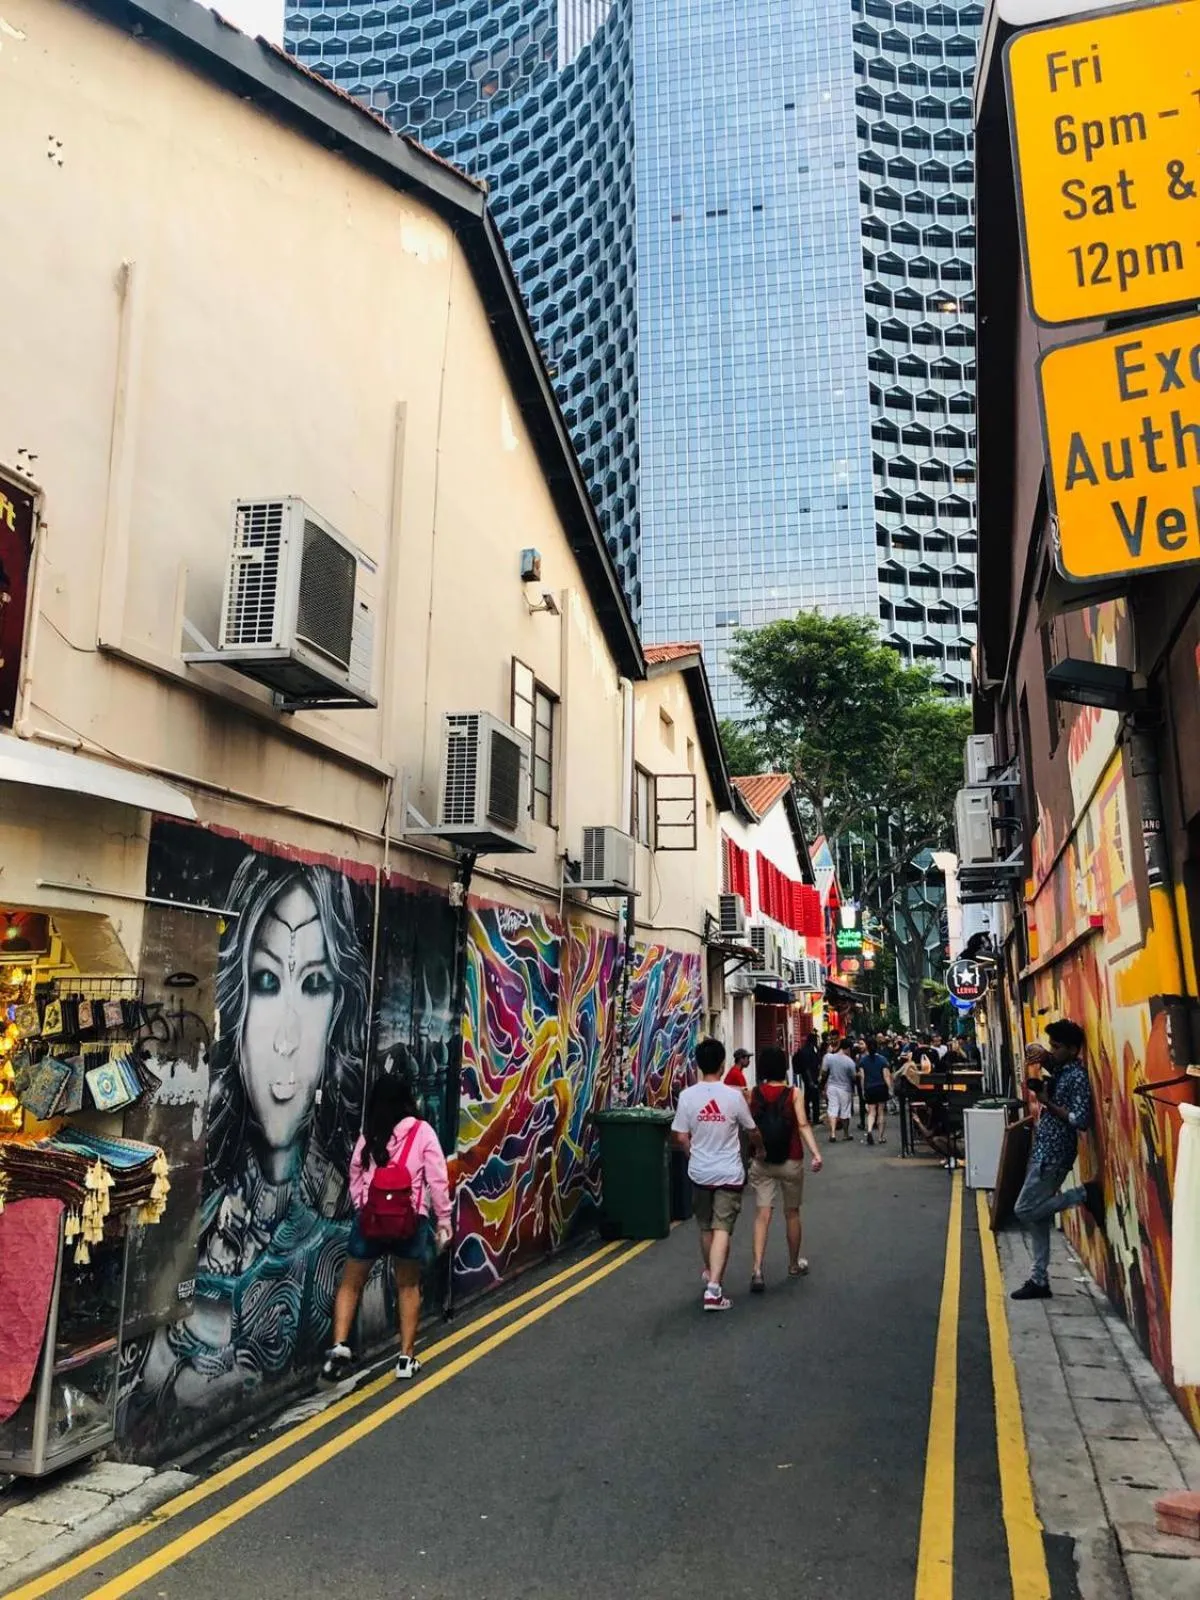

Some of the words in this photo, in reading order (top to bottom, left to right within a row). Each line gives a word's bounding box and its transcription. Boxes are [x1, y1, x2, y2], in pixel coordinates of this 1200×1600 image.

[1046, 44, 1102, 93] Fri
[1054, 111, 1147, 163] 6pm
[1061, 169, 1137, 221] Sat
[1166, 159, 1198, 201] &
[1067, 239, 1184, 293] 12pm
[837, 930, 861, 939] Juice
[697, 1113, 725, 1122] adidas
